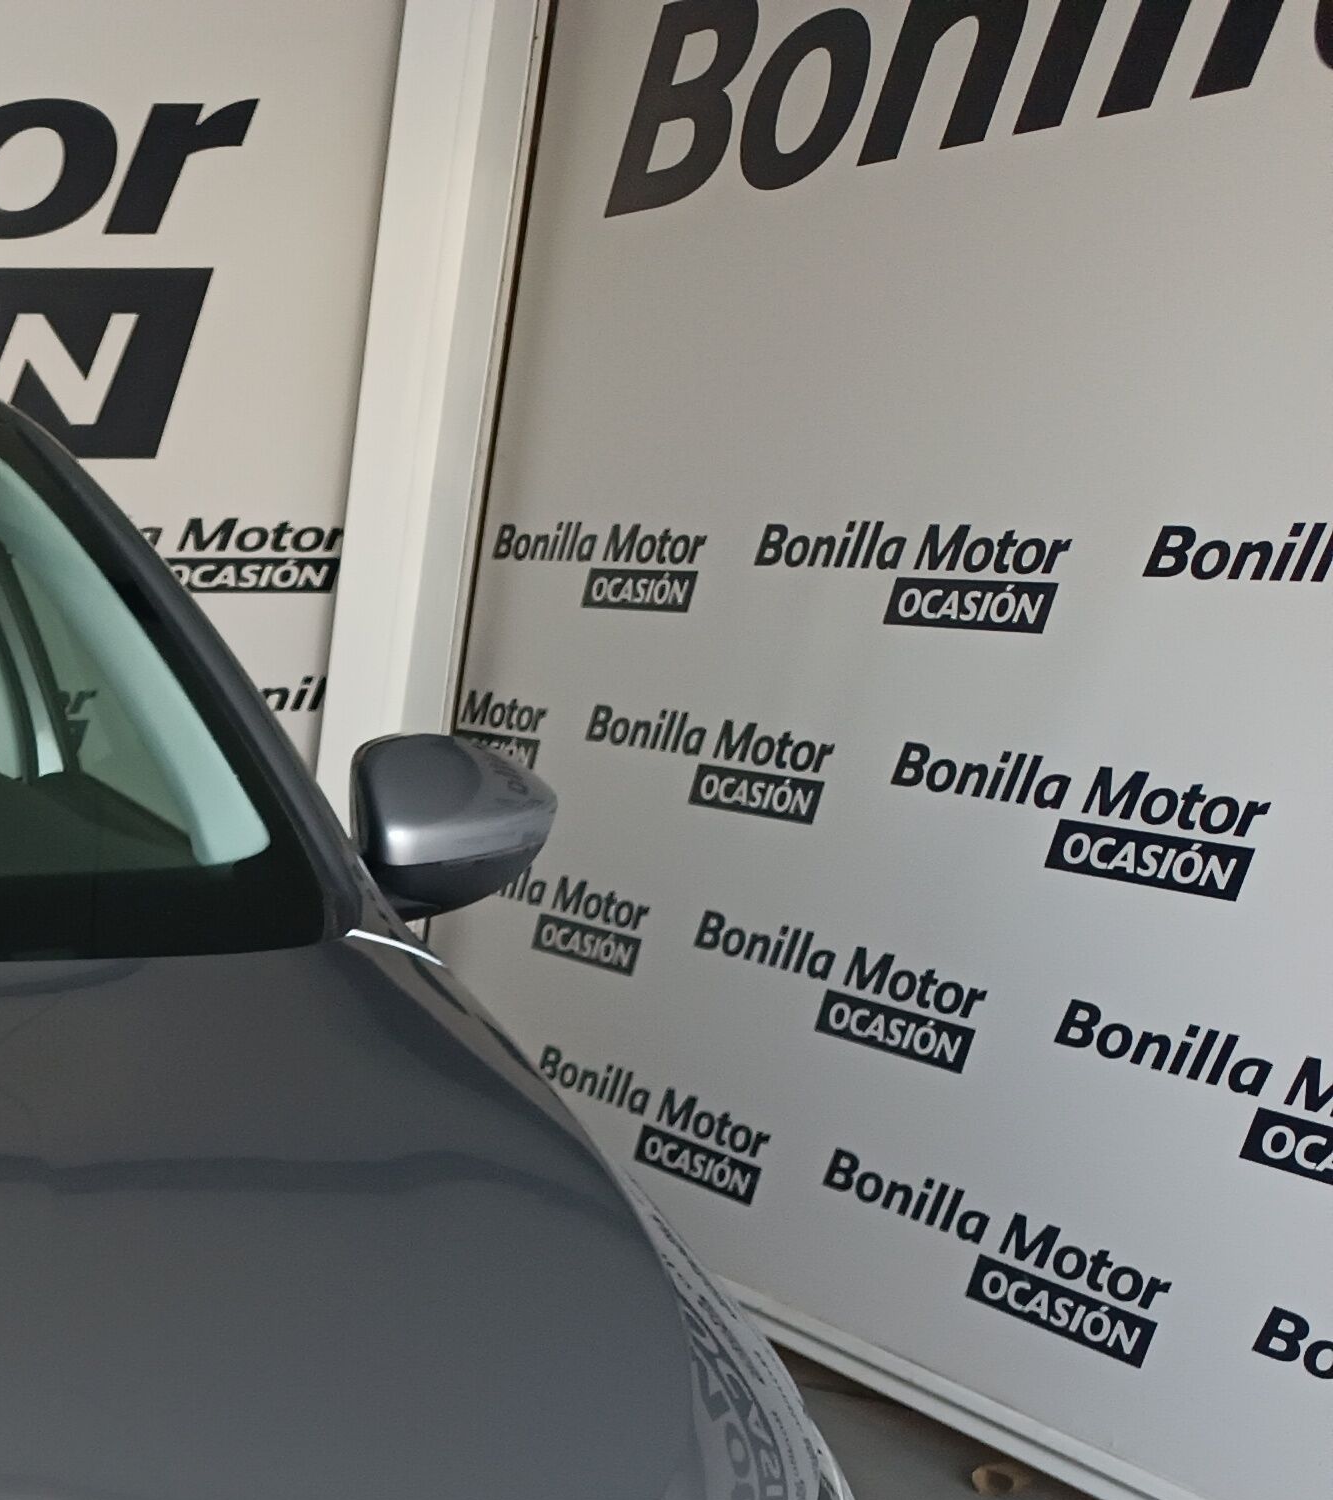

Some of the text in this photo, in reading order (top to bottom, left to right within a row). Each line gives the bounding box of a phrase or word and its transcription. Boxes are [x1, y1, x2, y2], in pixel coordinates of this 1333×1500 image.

[177, 518, 343, 552] Motor
[492, 522, 707, 565] Bonilla Motor
[754, 521, 1072, 574] Bonilla Motor
[592, 572, 689, 604] OCASIÓN
[899, 585, 1044, 624] OCASIÓN
[460, 690, 546, 732] Motor
[586, 705, 706, 756] Bonilla
[713, 720, 835, 773] Motor
[701, 775, 813, 815] OCASIÓN
[891, 742, 1271, 837] Bonilla Motor
[1063, 833, 1237, 889] OCASIÓN
[551, 876, 650, 930] Motor
[542, 922, 635, 968] OCASIÓN
[694, 910, 987, 1019] Bonilla Motor
[829, 1001, 964, 1063] OCASIÓN
[1054, 999, 1273, 1096] Bonilla
[539, 1045, 771, 1157] Bonilla Motor
[645, 1135, 752, 1195] OCASIÓN
[823, 1148, 1172, 1309] Bonilla Motor
[983, 1269, 1141, 1354] OCASIÓN
